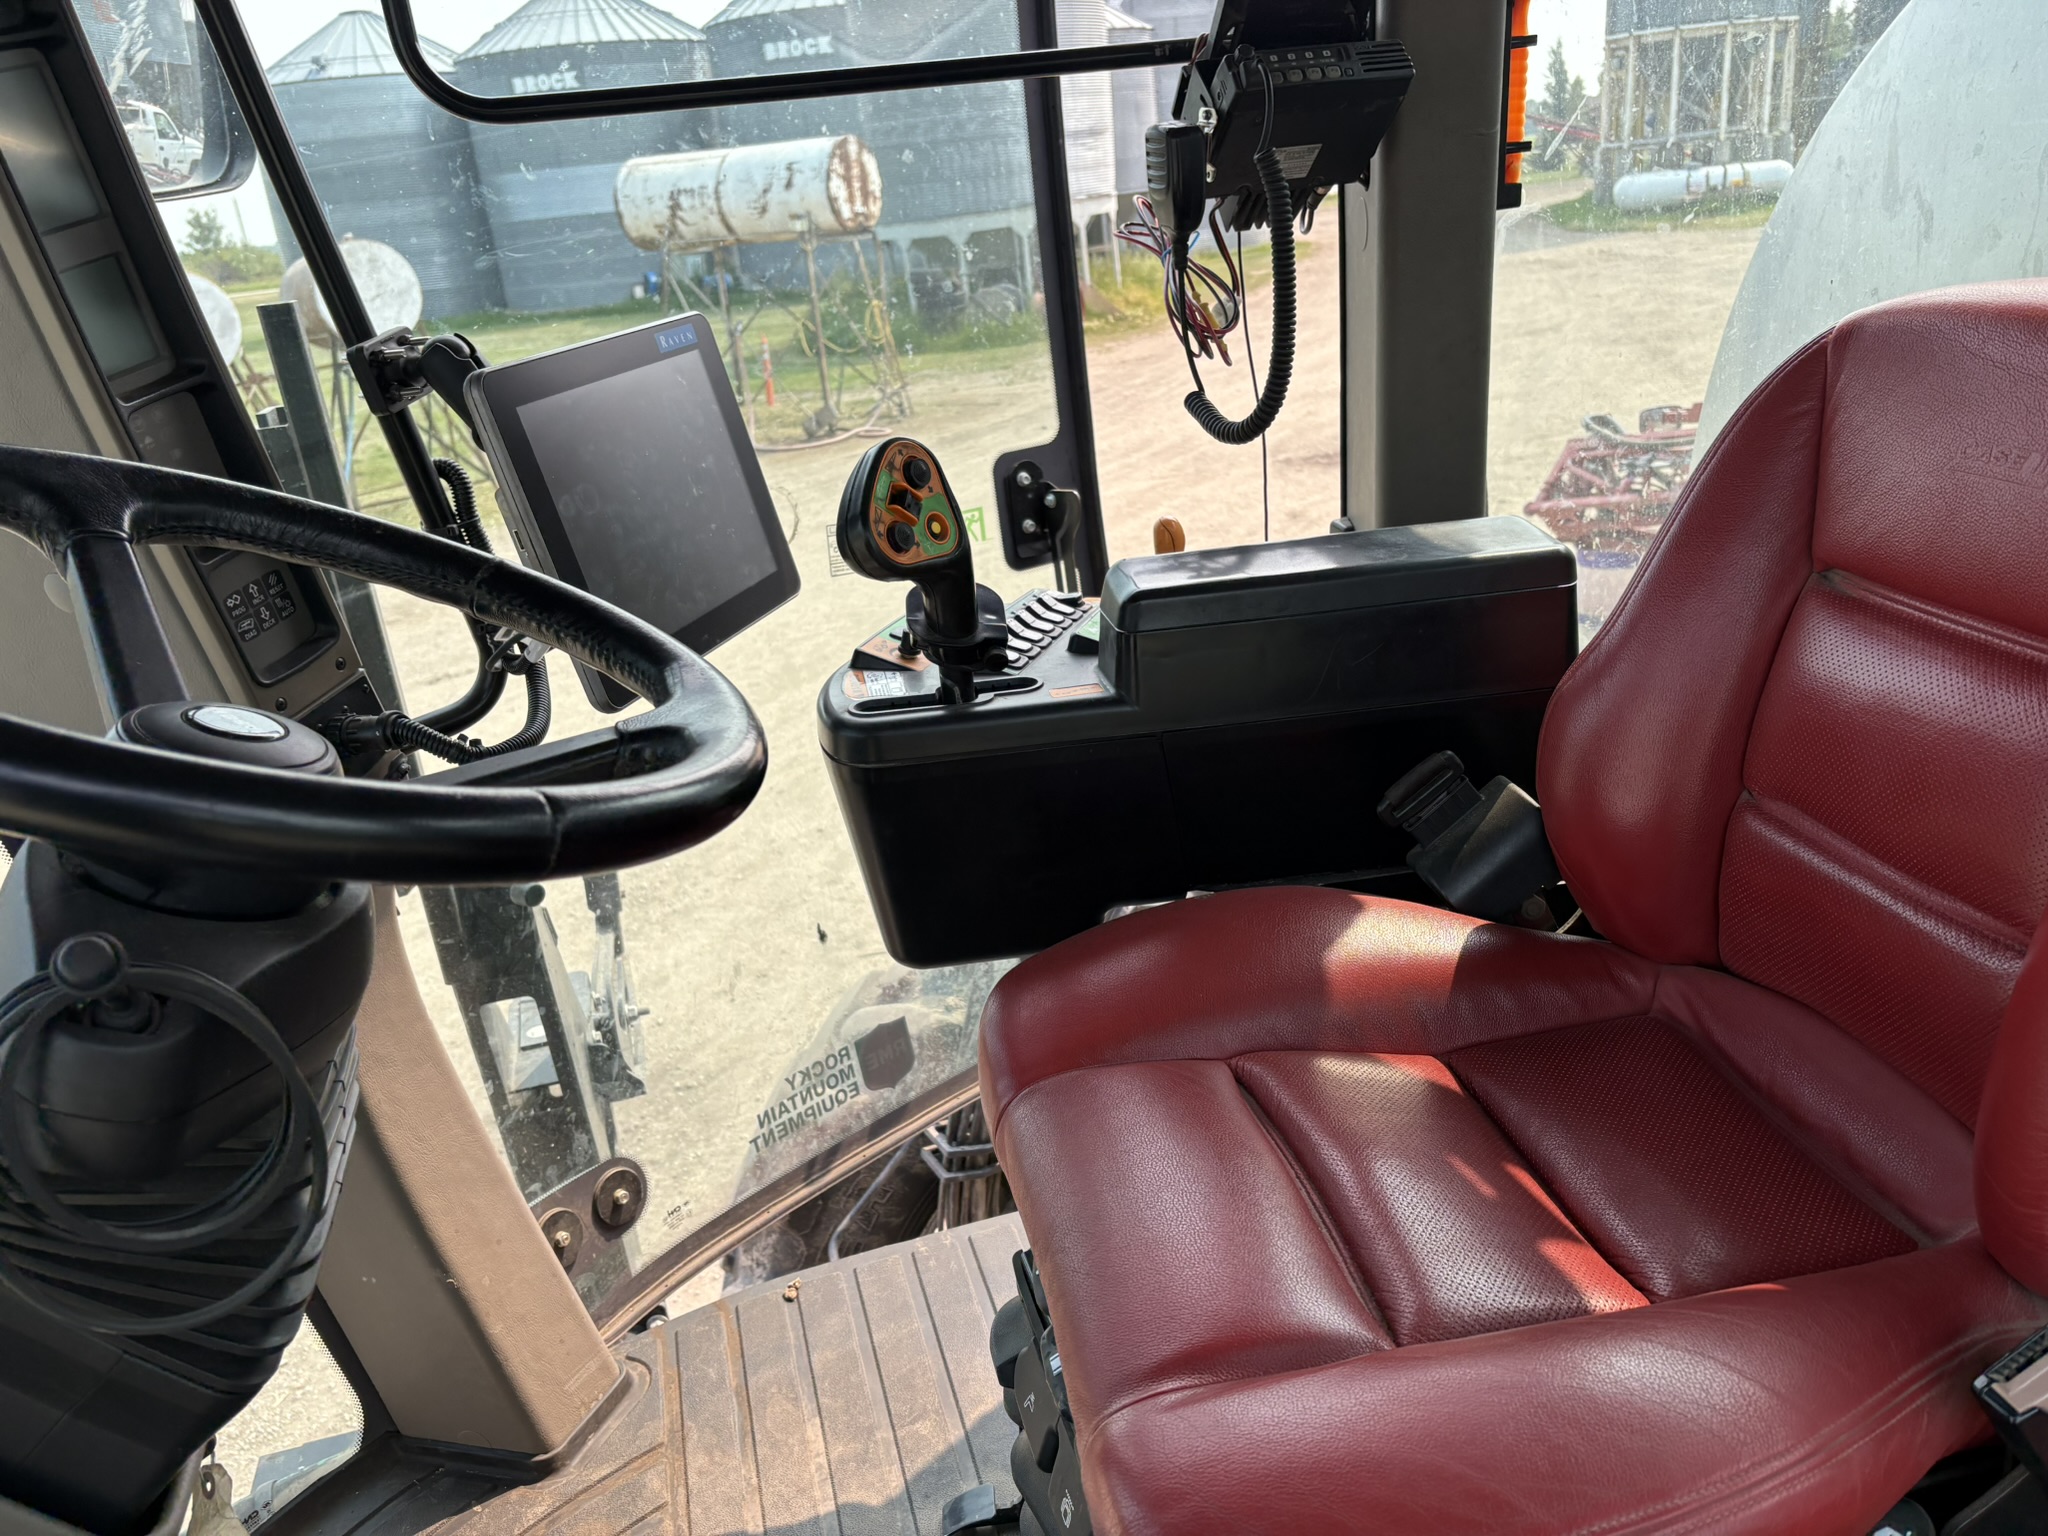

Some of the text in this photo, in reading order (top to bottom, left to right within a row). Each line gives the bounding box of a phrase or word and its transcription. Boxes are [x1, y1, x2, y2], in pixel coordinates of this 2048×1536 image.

[762, 35, 834, 61] BROCK
[511, 70, 580, 94] BROCK
[659, 331, 693, 349] RAVEN
[269, 583, 283, 595] RESET
[252, 594, 265, 605] INCR
[231, 605, 246, 617] PROG
[281, 606, 294, 617] AUTO
[262, 617, 276, 629] DECR
[244, 629, 257, 640] DIAG
